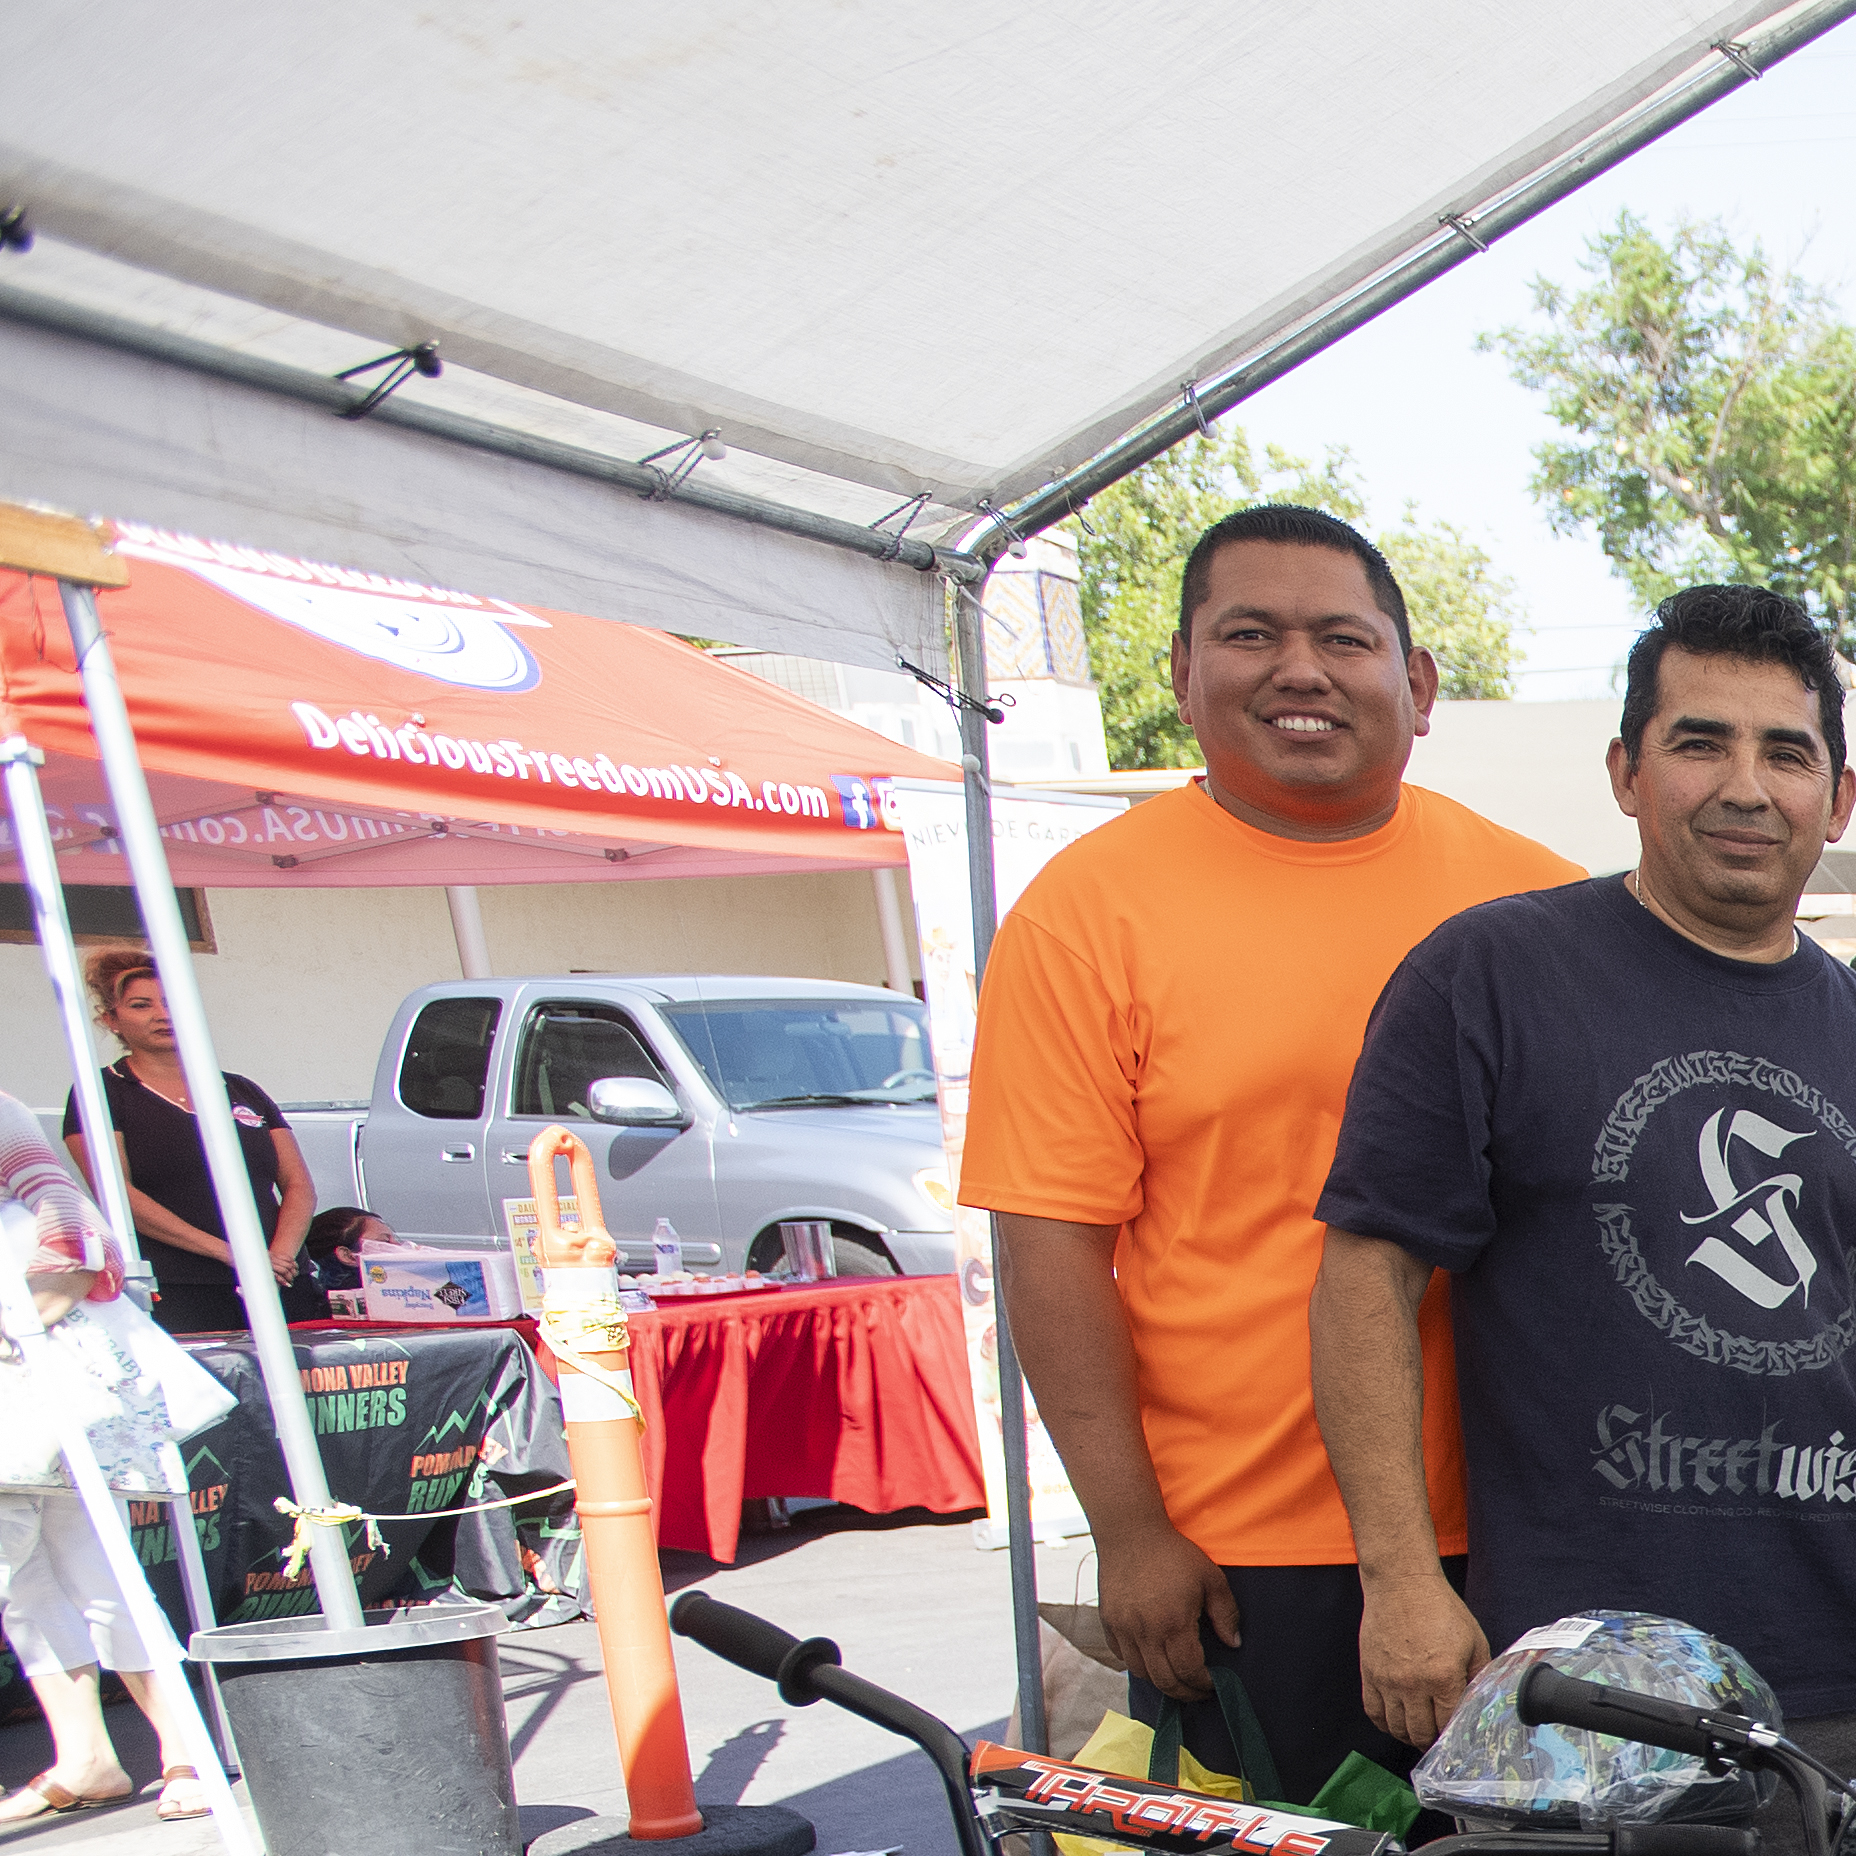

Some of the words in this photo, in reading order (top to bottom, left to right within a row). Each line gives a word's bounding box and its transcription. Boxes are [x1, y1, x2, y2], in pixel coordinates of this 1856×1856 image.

[288, 700, 831, 819] DeliciousFreedomUSA.com
[911, 821, 967, 850] NIEV
[380, 1286, 431, 1301] Napkins
[348, 1360, 410, 1388] VALLEY
[305, 1387, 408, 1437] UNNERS
[190, 1483, 230, 1515] LLEY
[1599, 1496, 1671, 1514] STREETWISE
[1673, 1504, 1735, 1517] CLOTHING
